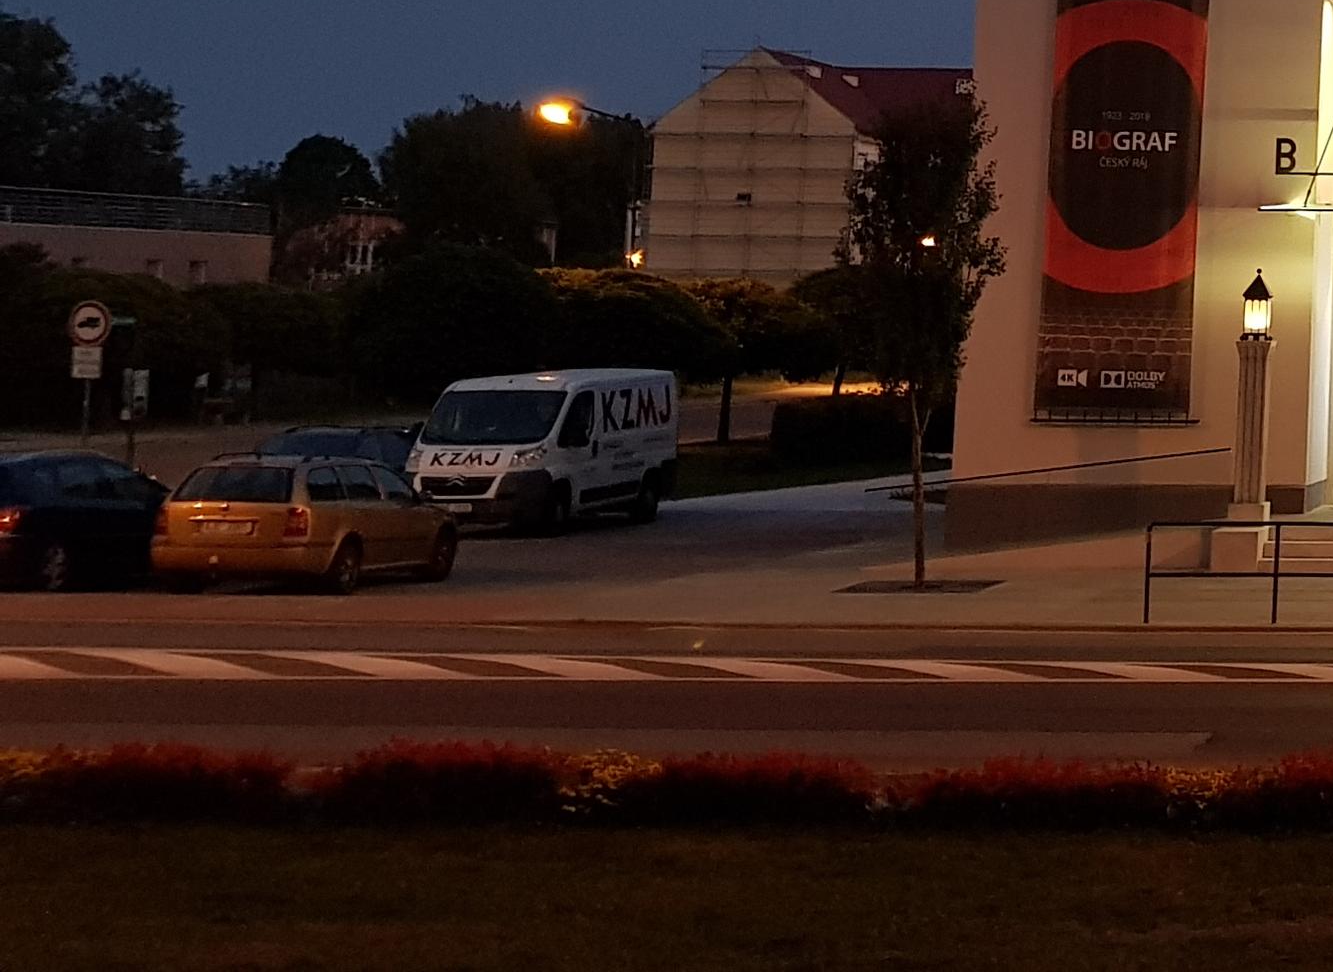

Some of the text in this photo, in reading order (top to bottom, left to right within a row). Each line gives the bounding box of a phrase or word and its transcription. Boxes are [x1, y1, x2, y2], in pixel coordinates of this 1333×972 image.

[1071, 129, 1178, 152] BIOGRAF
[1132, 156, 1148, 170] RÁJ
[1060, 373, 1075, 382] 4K
[1126, 371, 1166, 382] DOLBY
[601, 384, 672, 433] KZMJ
[429, 451, 501, 467] KZMJ
